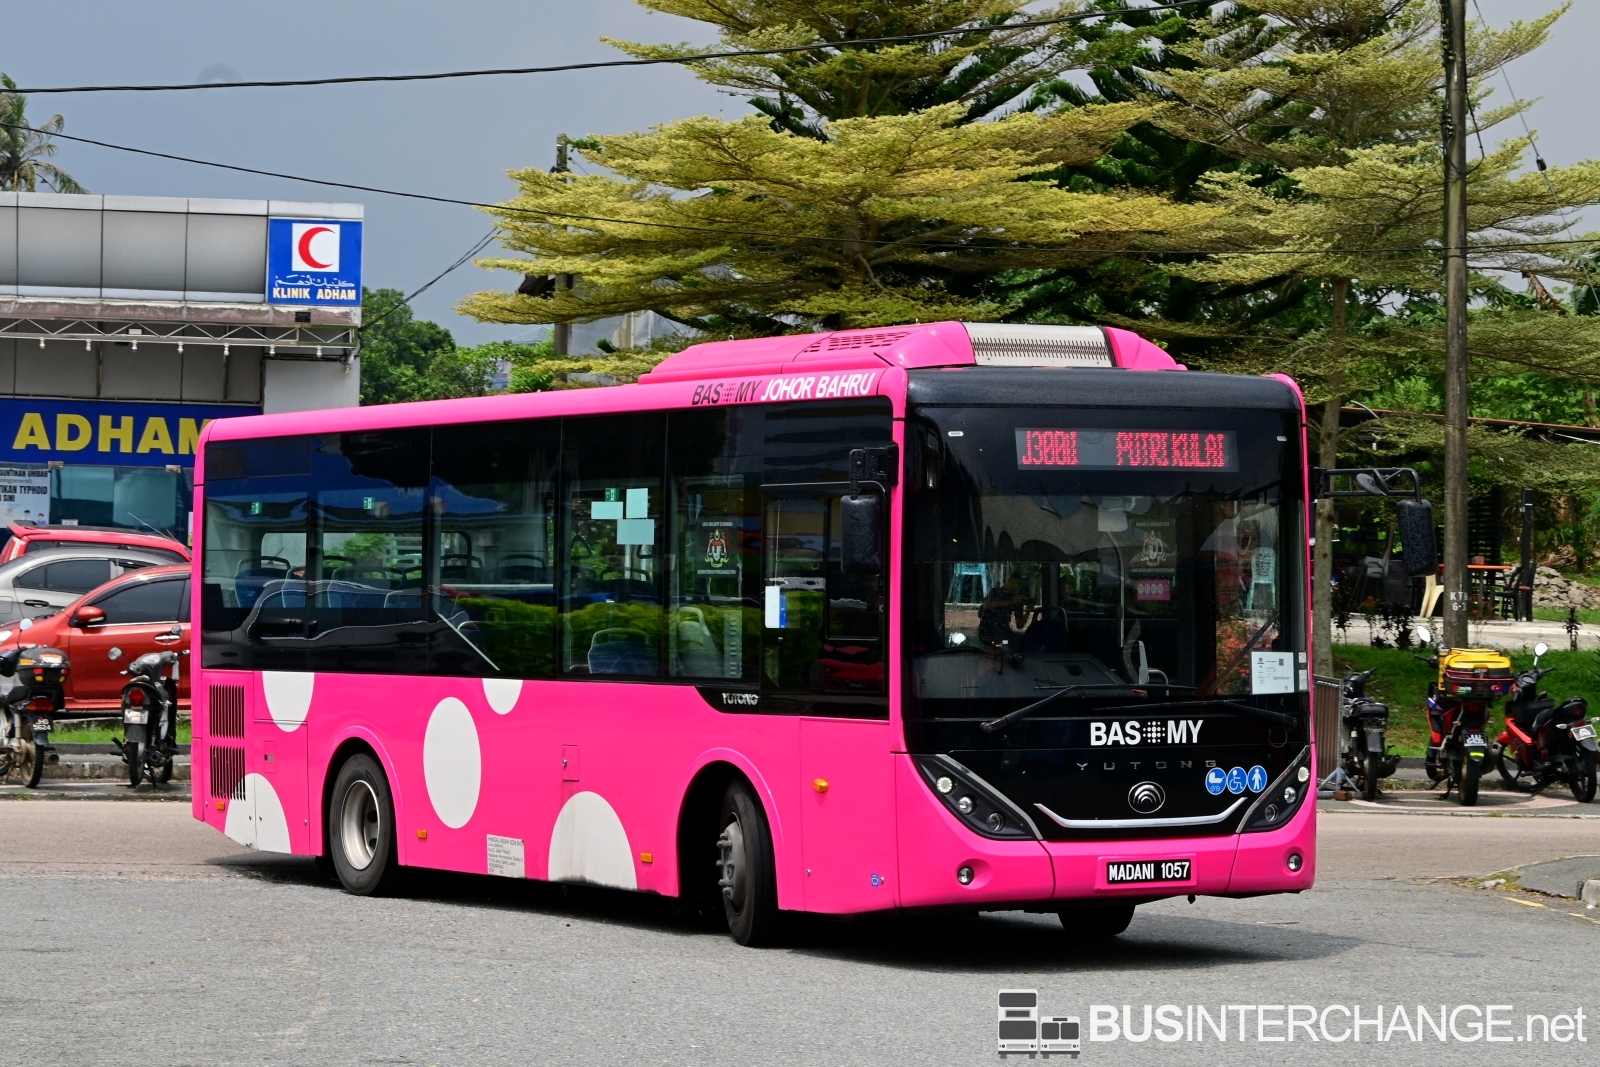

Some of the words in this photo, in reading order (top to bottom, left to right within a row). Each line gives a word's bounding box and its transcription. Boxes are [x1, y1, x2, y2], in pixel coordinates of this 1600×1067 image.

[273, 287, 310, 299] KLINIK
[316, 288, 356, 300] ADHAM
[692, 382, 723, 405] BAS
[735, 380, 763, 402] MY
[760, 377, 814, 401] JOHOR
[815, 372, 876, 398] BAHRU
[19, 485, 48, 494] TYPHOID
[722, 692, 759, 705] YUTONG
[1090, 721, 1142, 746] BAS
[1167, 719, 1204, 744] MY
[1076, 759, 1217, 770] YUTONG
[1109, 863, 1155, 881] MADANI
[1160, 862, 1190, 879] 1057
